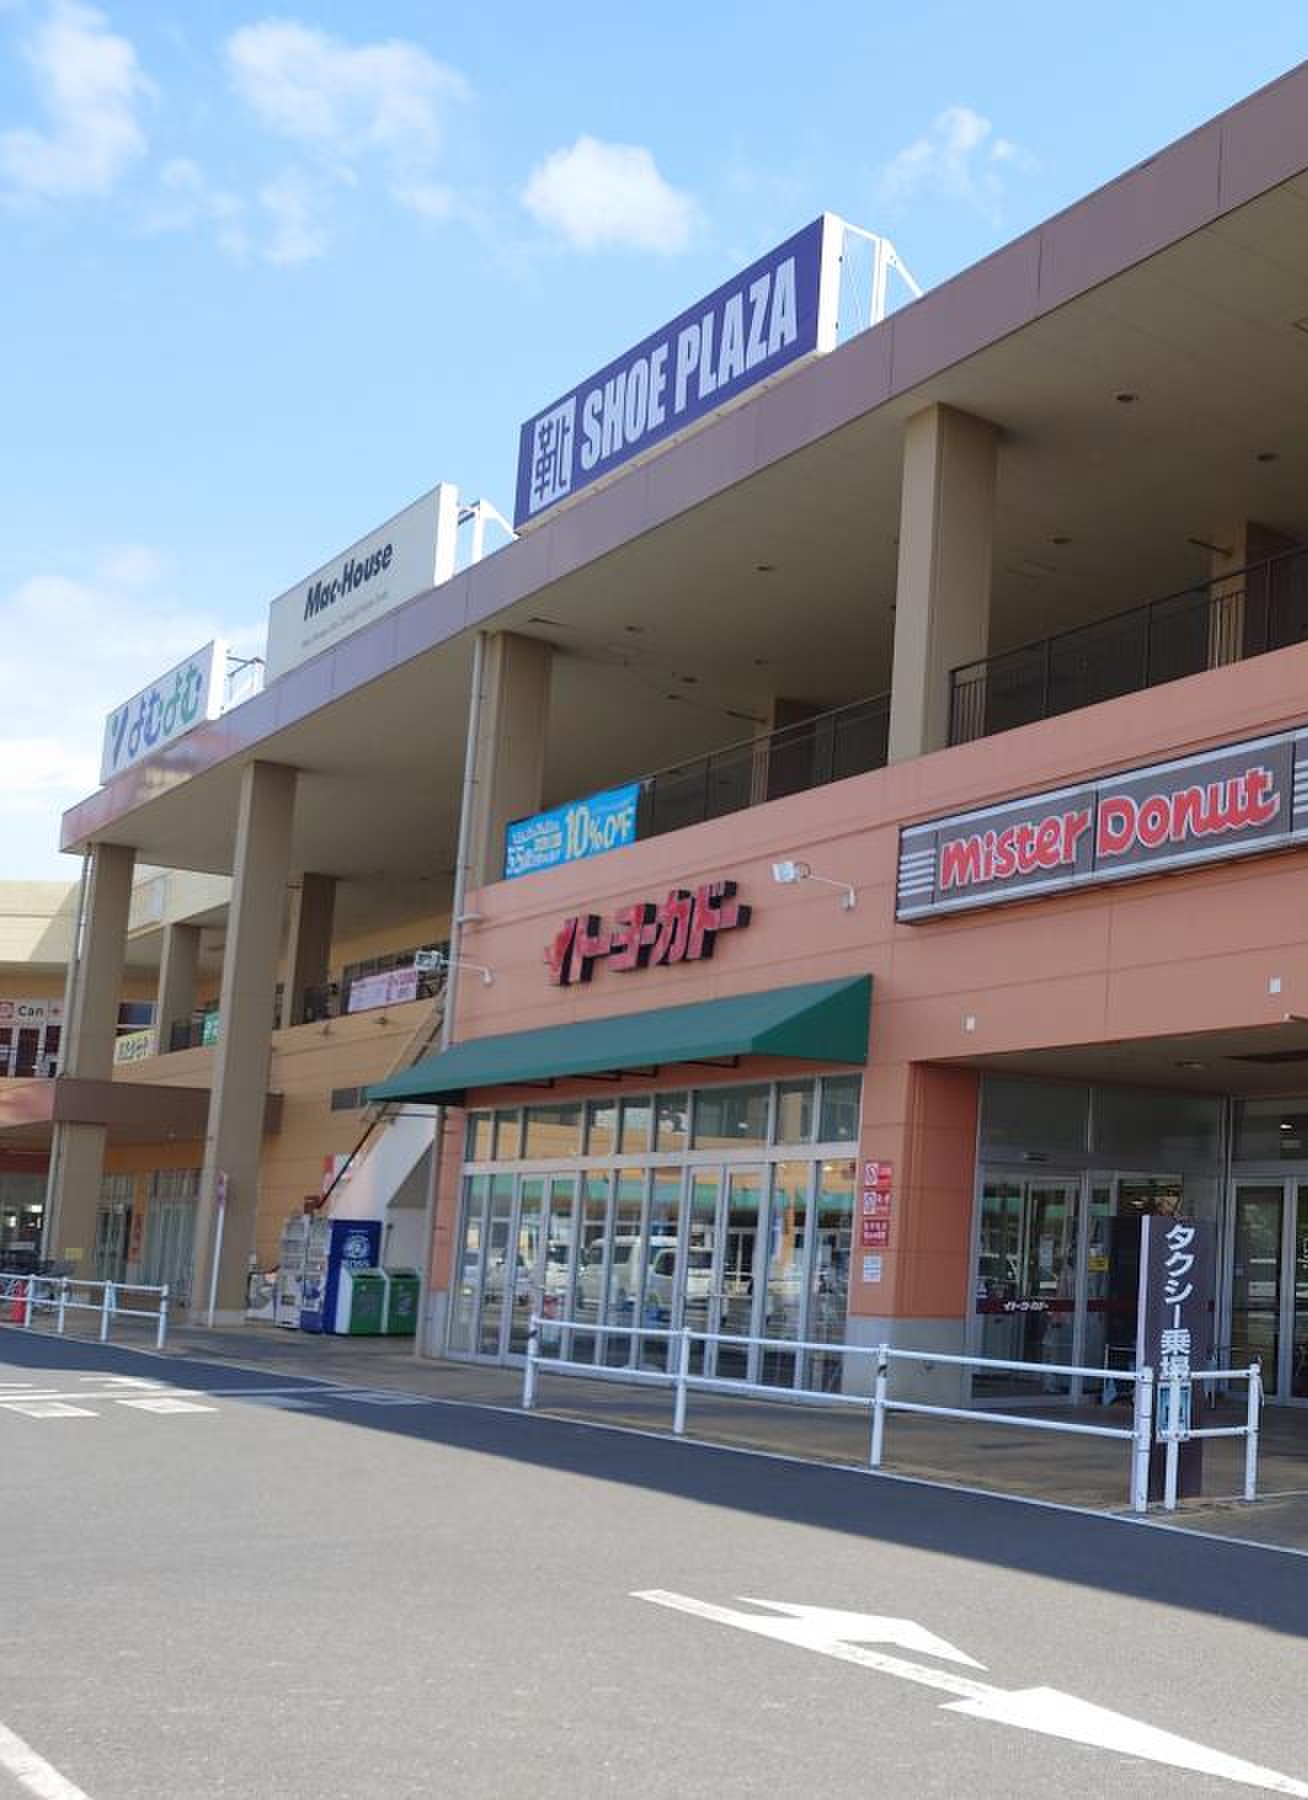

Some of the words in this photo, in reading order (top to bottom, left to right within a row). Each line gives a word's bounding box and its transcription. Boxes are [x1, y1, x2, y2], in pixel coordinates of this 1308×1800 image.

[533, 408, 573, 501] 靴
[581, 343, 668, 471] SHOE
[674, 256, 797, 415] PLAZA
[304, 543, 393, 621] Mac-House
[1098, 767, 1280, 857] Donut
